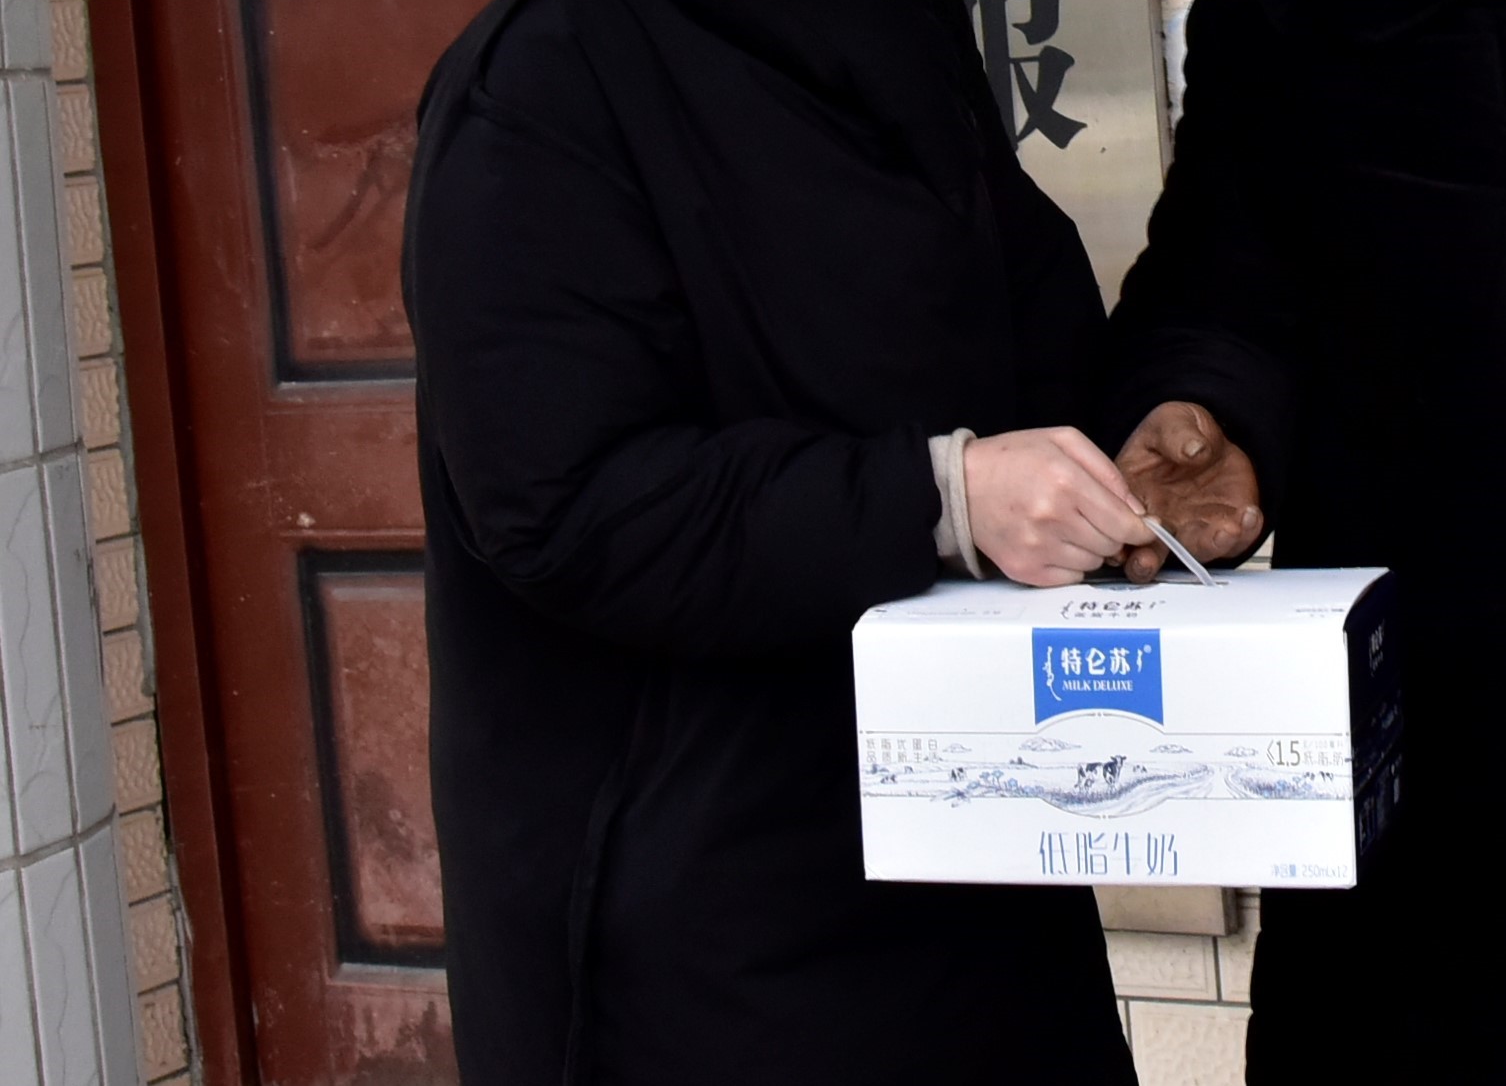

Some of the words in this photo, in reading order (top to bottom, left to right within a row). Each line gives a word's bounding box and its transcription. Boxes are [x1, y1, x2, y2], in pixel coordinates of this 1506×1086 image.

[1061, 647, 1131, 675] 特仑苏
[1062, 679, 1092, 691] MILK
[1093, 679, 1134, 691] DELUXE
[1039, 831, 1178, 876] 低脂牛奶
